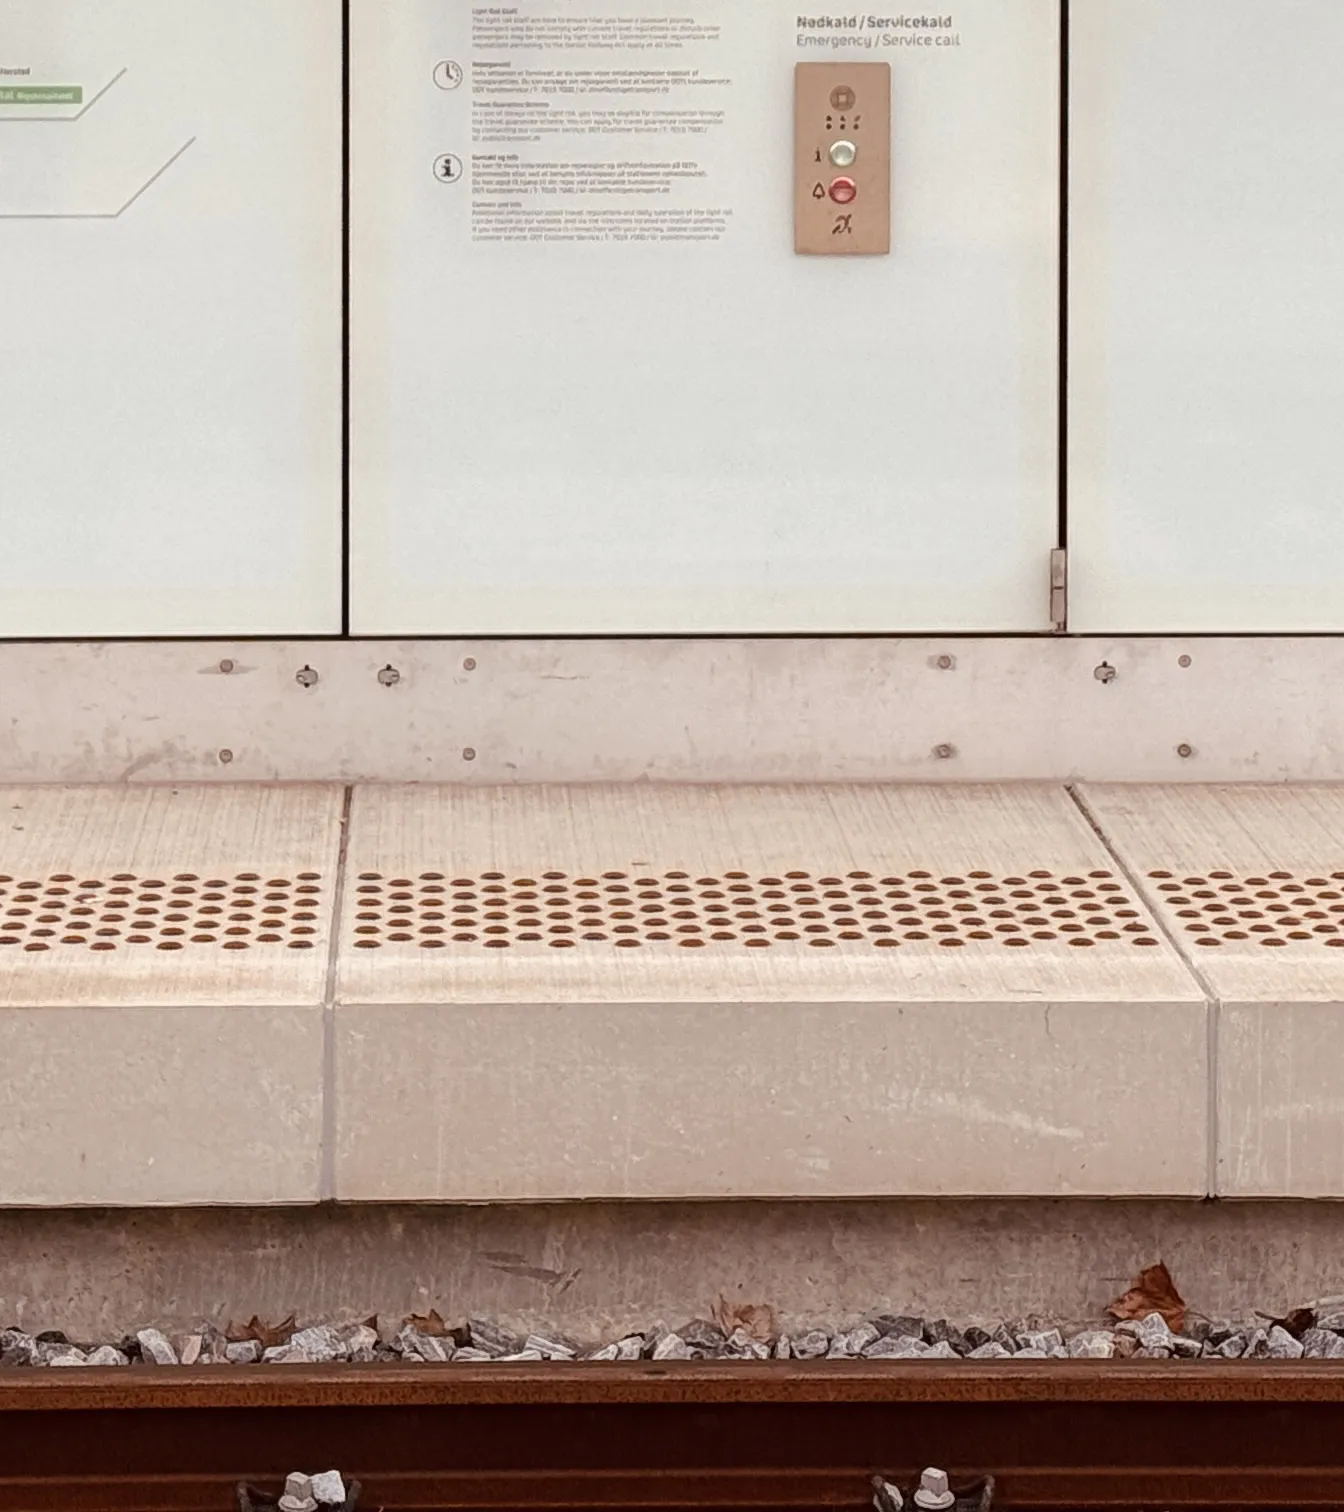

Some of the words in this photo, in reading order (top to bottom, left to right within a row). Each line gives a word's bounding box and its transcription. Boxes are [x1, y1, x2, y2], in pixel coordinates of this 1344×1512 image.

[797, 16, 857, 29] Nødkald
[867, 15, 952, 28] Servicekald
[797, 34, 871, 49] Emergency
[882, 33, 932, 46] Service
[935, 34, 960, 46] call
